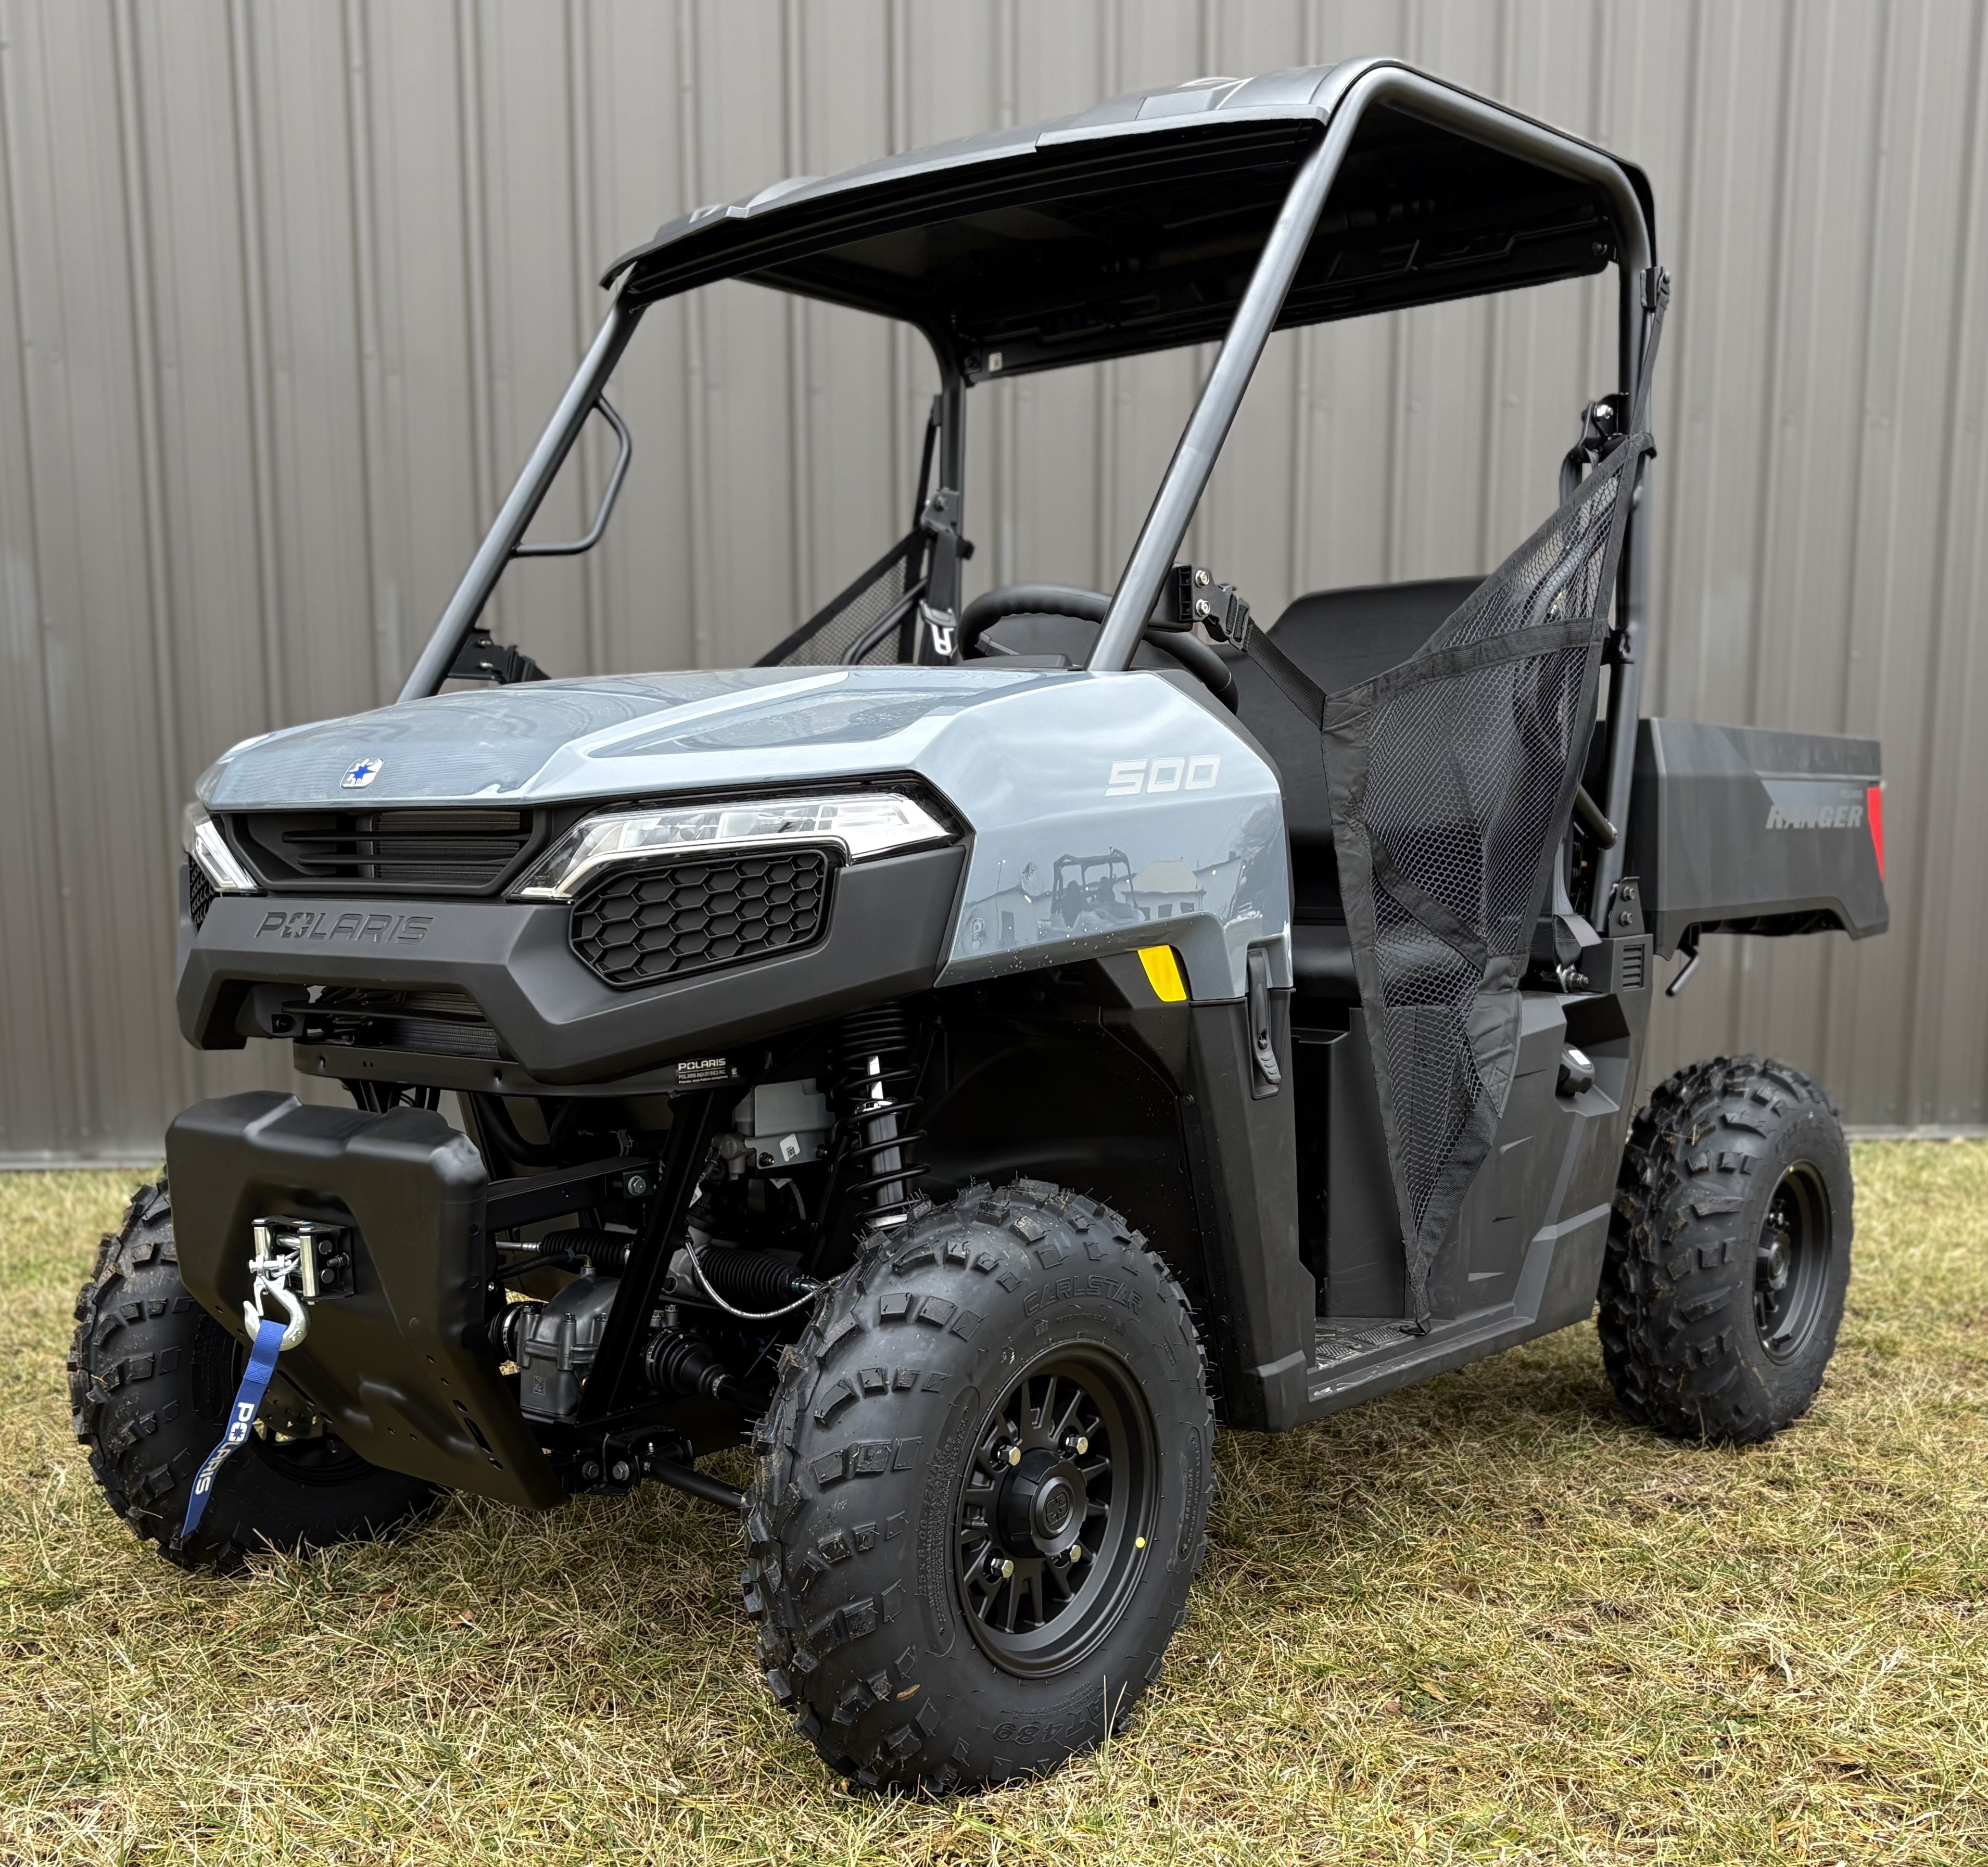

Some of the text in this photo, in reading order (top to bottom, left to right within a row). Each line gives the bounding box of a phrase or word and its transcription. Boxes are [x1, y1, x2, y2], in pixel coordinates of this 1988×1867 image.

[1105, 754, 1221, 796] 500
[1766, 806, 1863, 829] RANGER
[253, 912, 434, 945] POLARIS
[678, 1058, 726, 1071] POLARIS
[1023, 1275, 1143, 1317] CARLSTAR
[195, 1402, 255, 1495] POLARIS
[993, 1689, 1108, 1745] AT489
